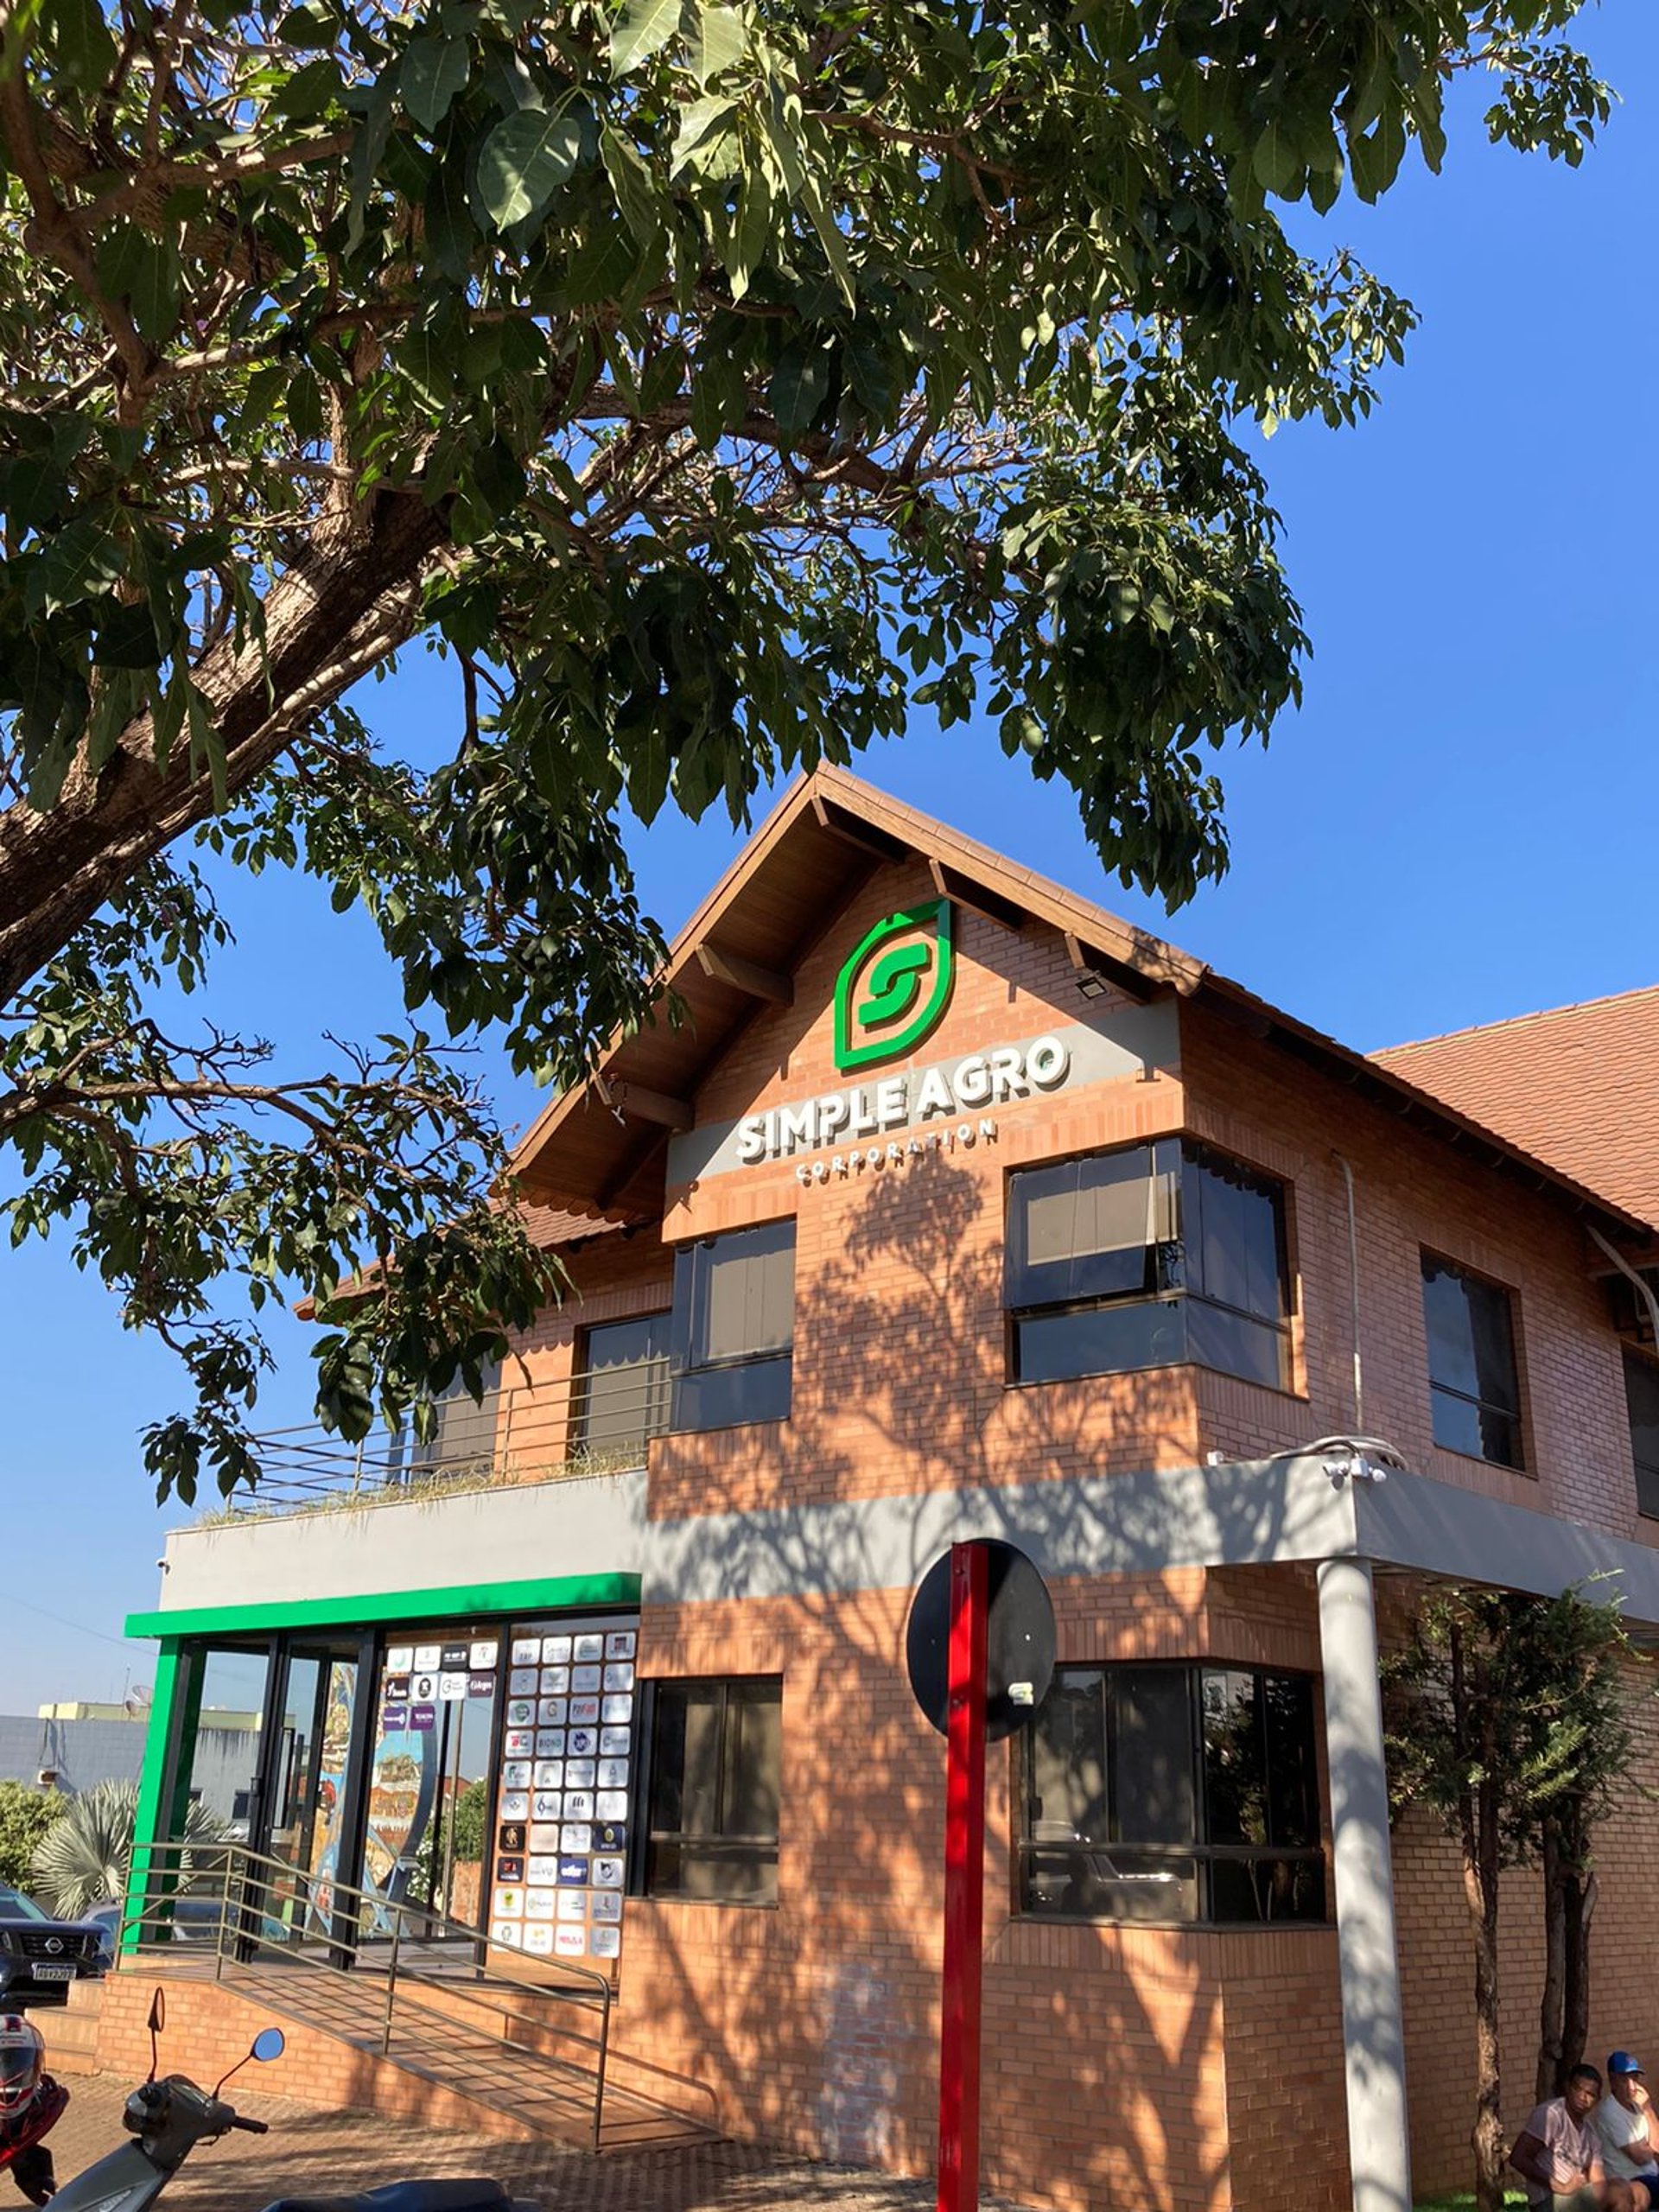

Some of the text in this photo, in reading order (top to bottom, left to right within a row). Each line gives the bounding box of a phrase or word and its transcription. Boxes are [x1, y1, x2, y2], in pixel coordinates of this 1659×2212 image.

[736, 1036, 1069, 1160] SIMPLE AGRO
[796, 1119, 995, 1181] CORPORATION
